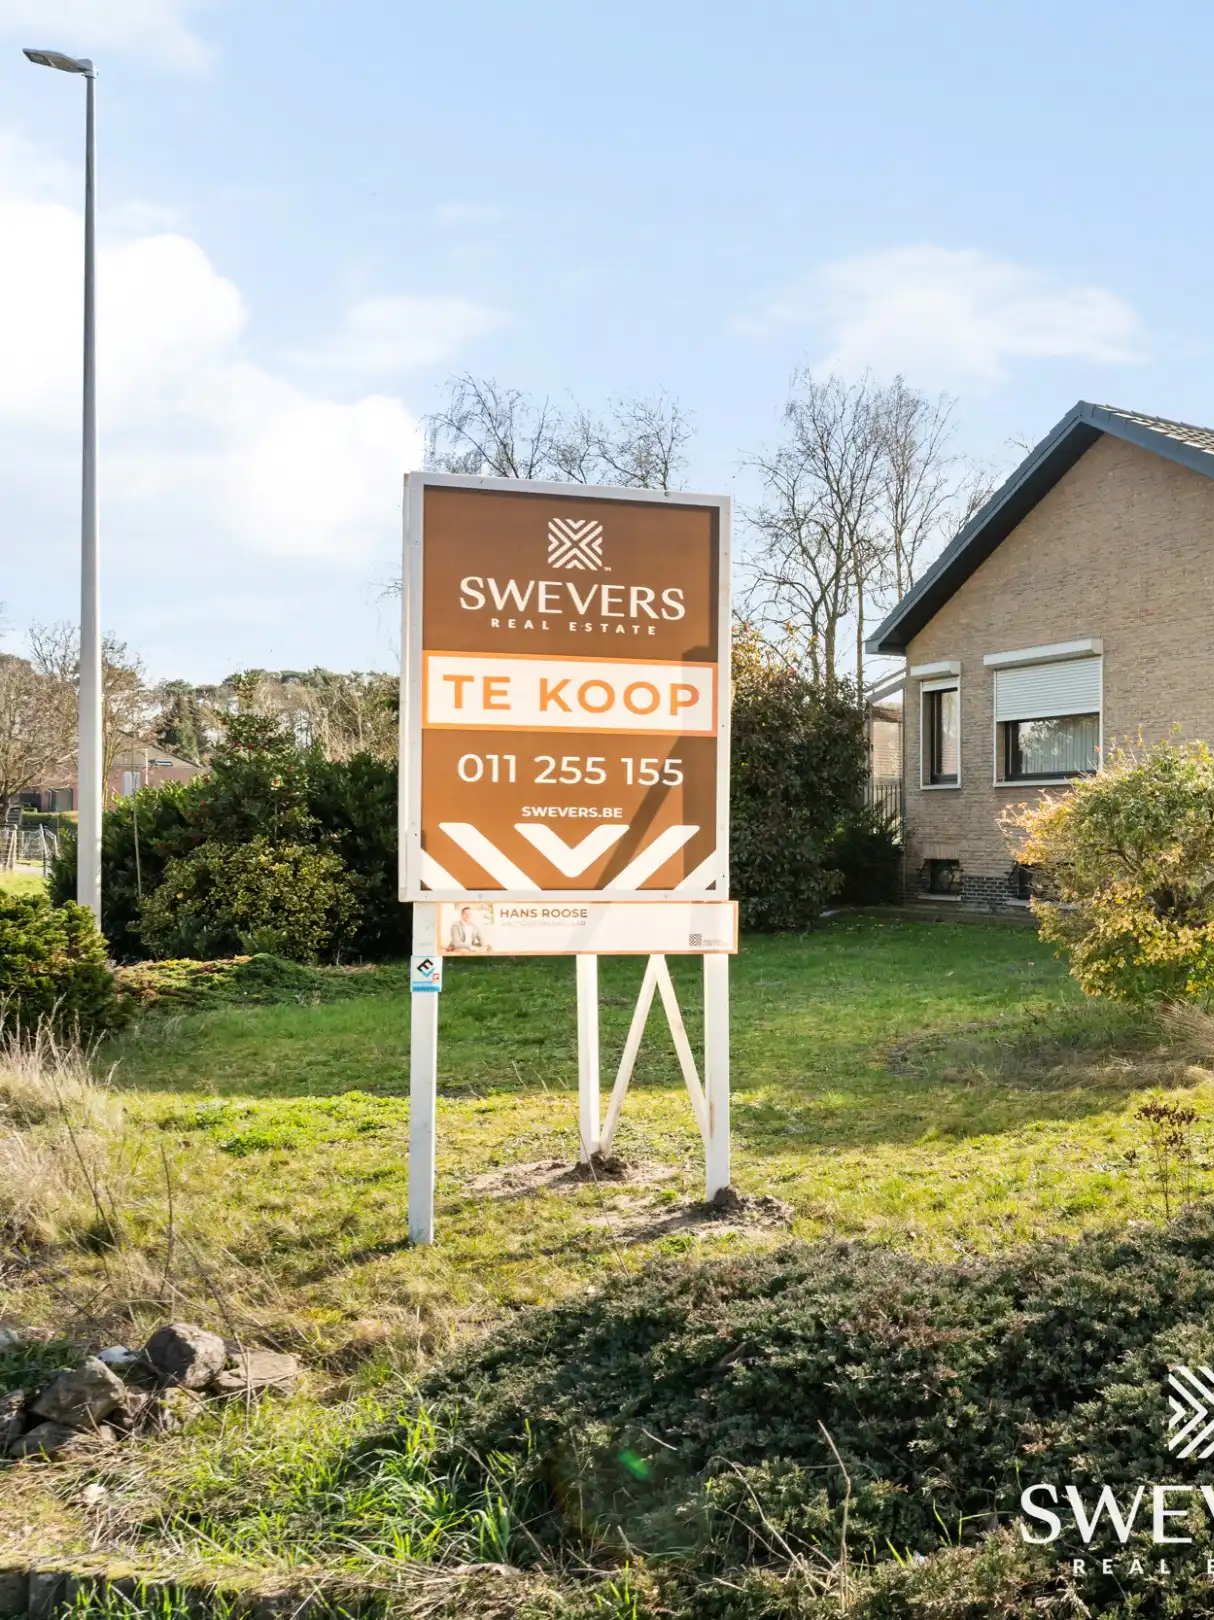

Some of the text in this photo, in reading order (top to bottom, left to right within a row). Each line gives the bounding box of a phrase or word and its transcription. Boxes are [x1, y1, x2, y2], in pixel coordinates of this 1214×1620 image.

[459, 576, 686, 621] SWEVERS
[490, 617, 657, 636] REAL ESTATE
[442, 674, 700, 716] TE KOOP
[457, 753, 684, 786] 011 255 155
[521, 806, 623, 818] SWEVERS.BE
[499, 908, 588, 918] HANS ROOSE
